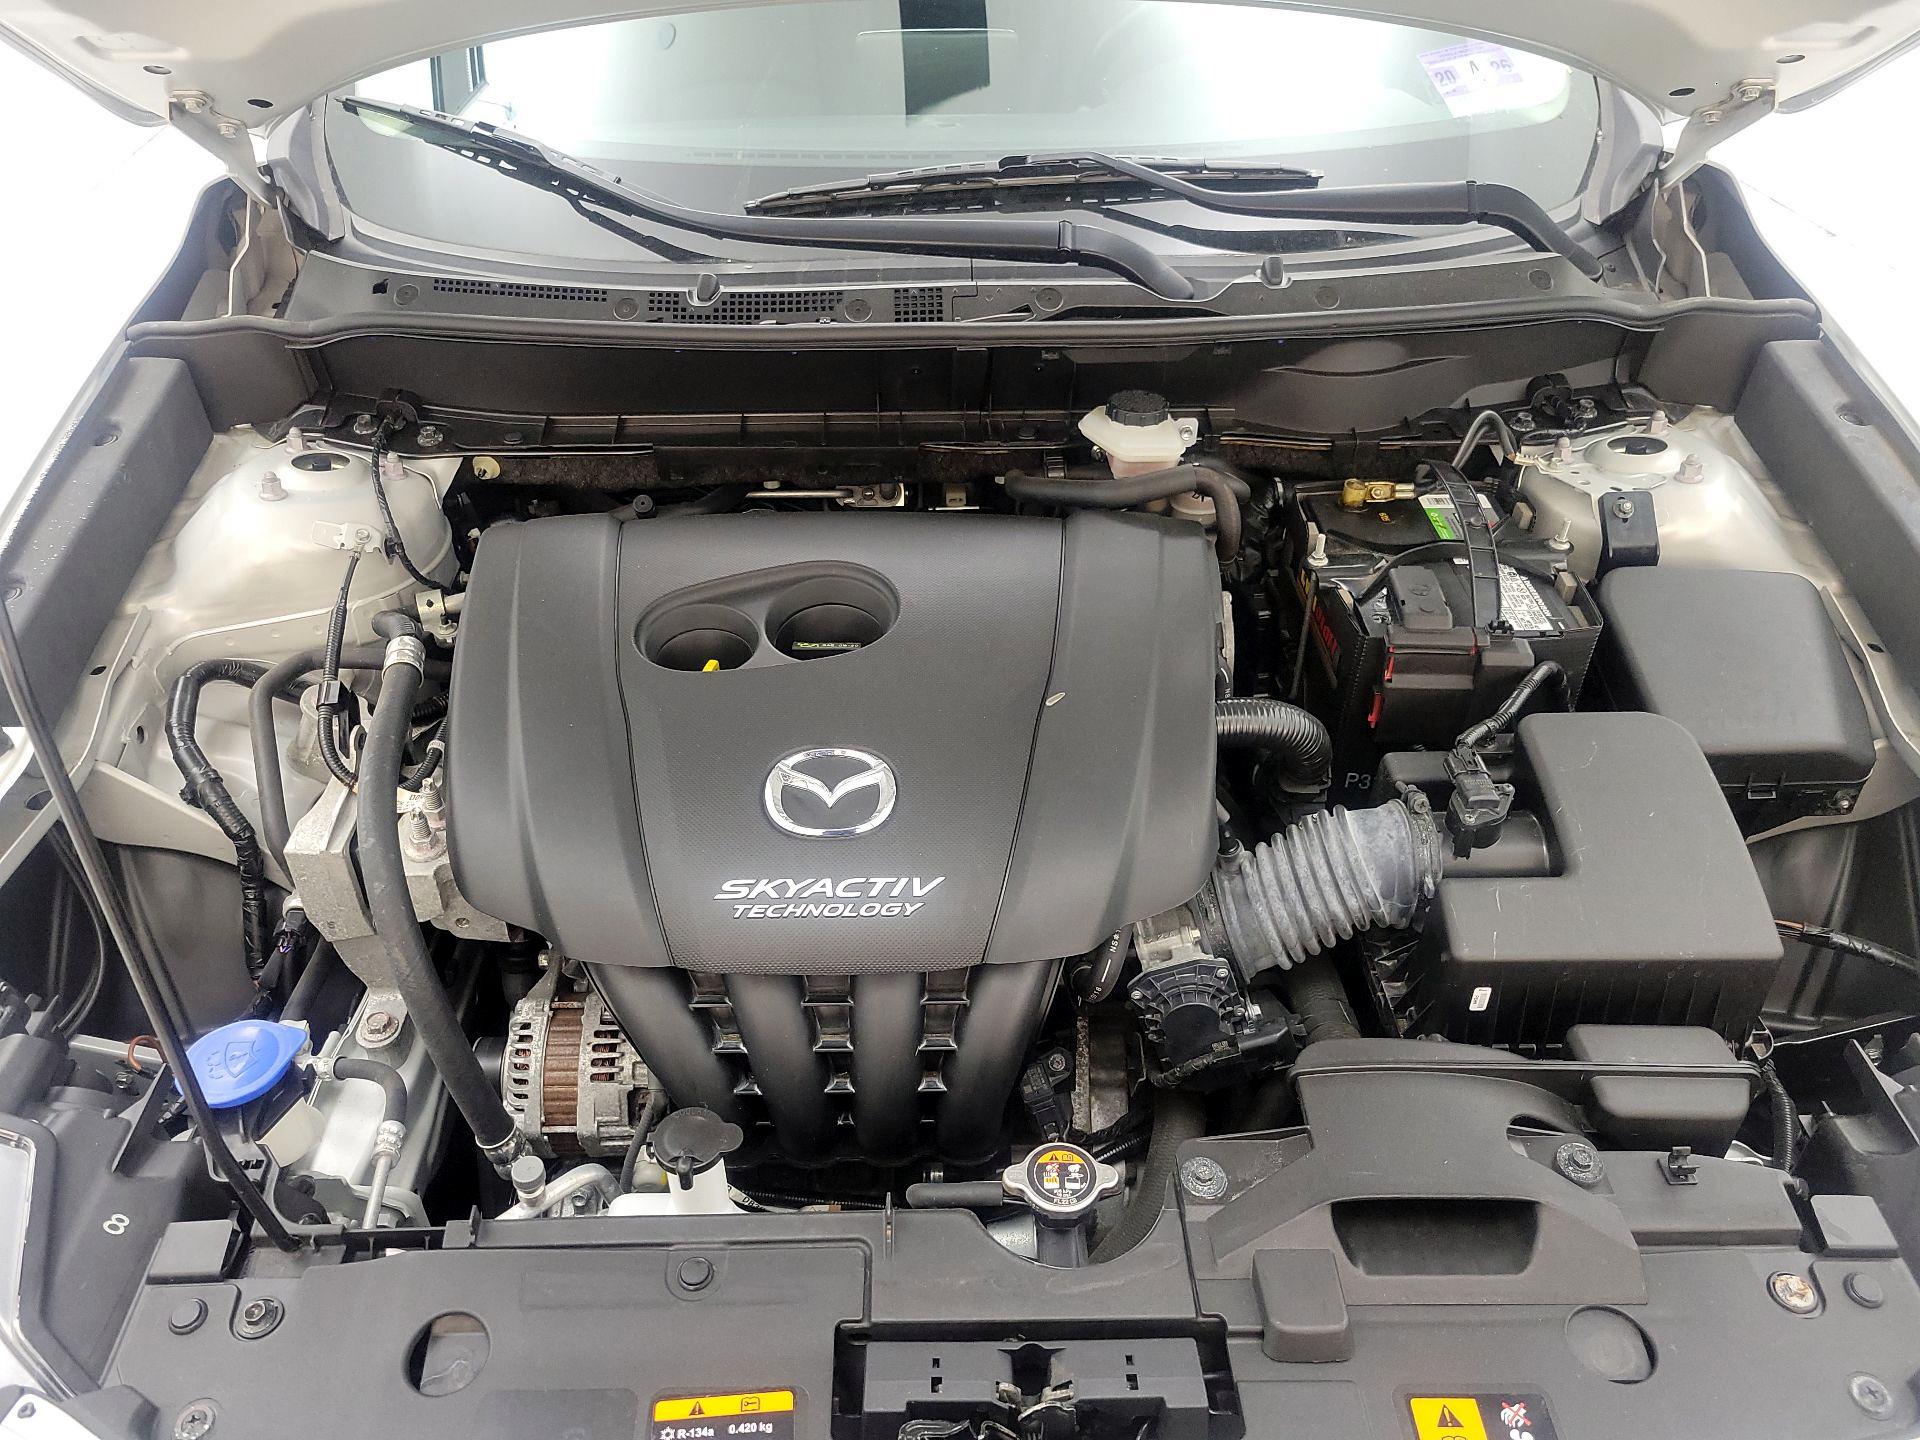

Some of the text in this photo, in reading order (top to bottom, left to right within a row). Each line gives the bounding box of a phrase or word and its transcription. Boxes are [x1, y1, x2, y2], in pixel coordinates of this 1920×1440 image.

[1345, 772, 1370, 789] P3
[713, 876, 946, 900] SKYACTIV
[732, 902, 925, 919] TECHNOLOGY
[676, 1421, 773, 1440] R-134a 0.420 kg
